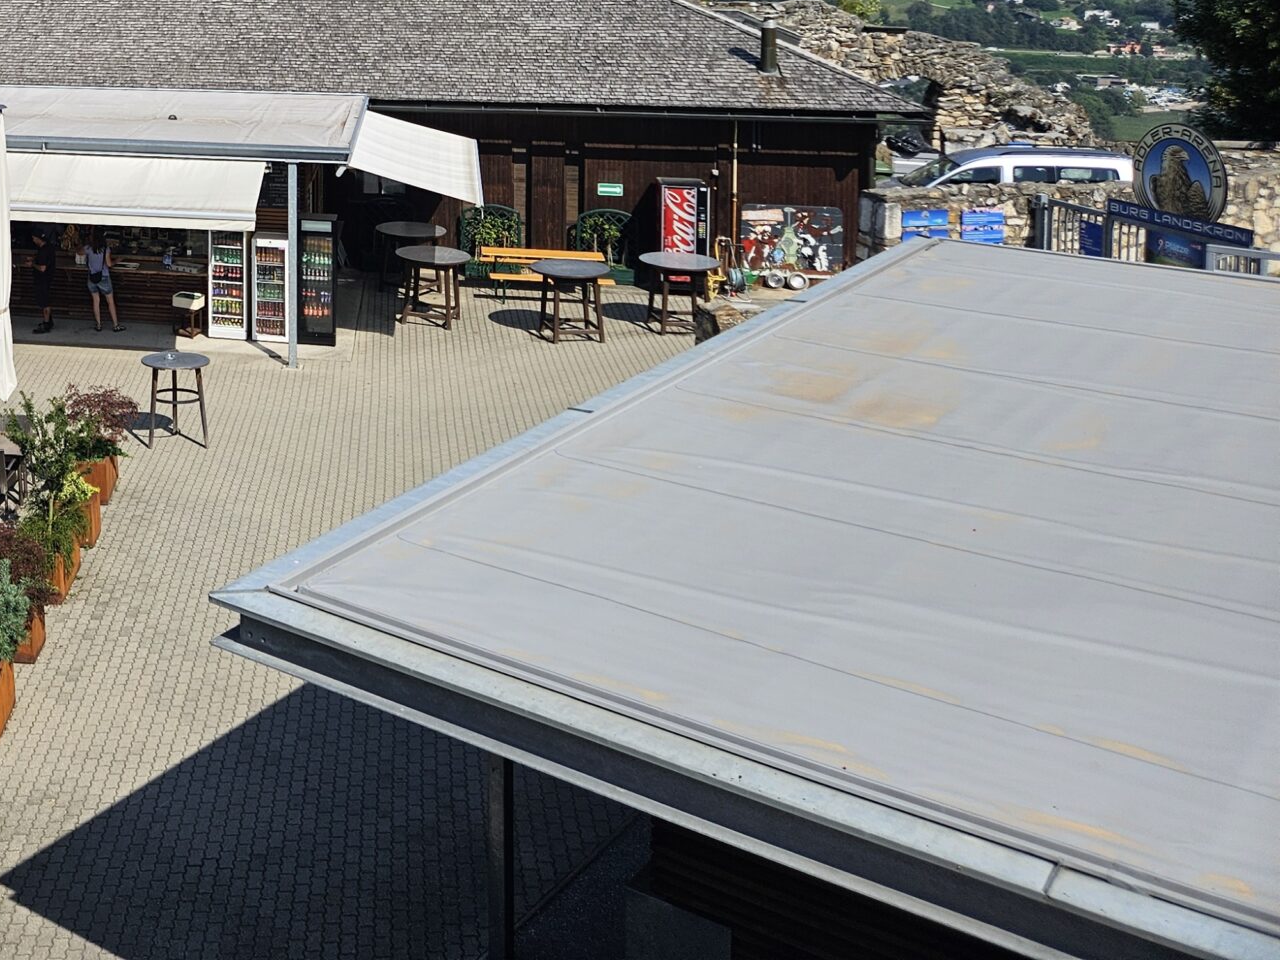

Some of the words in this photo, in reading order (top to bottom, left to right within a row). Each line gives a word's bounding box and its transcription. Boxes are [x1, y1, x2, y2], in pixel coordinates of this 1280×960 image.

[1134, 126, 1222, 189] ADLER-ARENA
[1109, 202, 1149, 219] BURG
[1154, 213, 1246, 242] LANDSKRON
